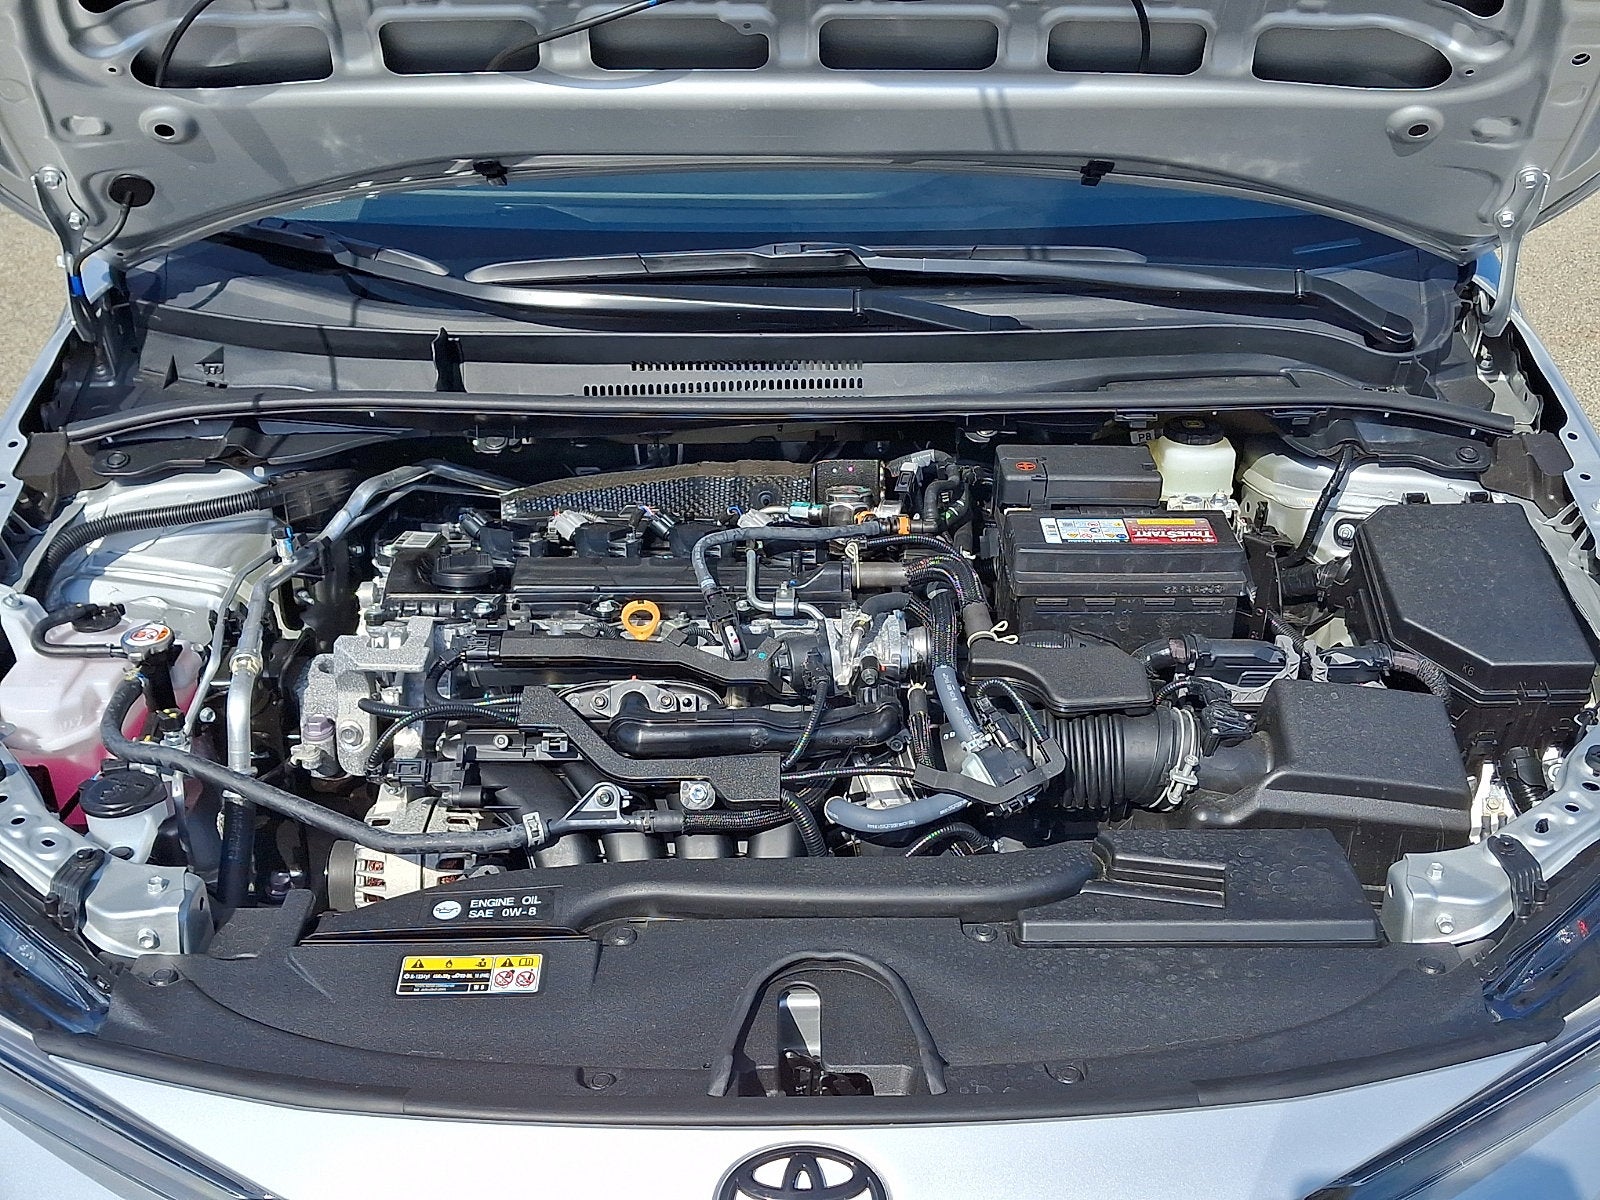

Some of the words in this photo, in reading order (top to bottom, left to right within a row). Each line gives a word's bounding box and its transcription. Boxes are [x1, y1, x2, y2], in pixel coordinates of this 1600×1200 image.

[1138, 432, 1152, 442] P8
[470, 897, 515, 908] ENGINE
[521, 895, 542, 905] OIL
[468, 909, 494, 918] SAE
[502, 907, 537, 917] 0W-8
